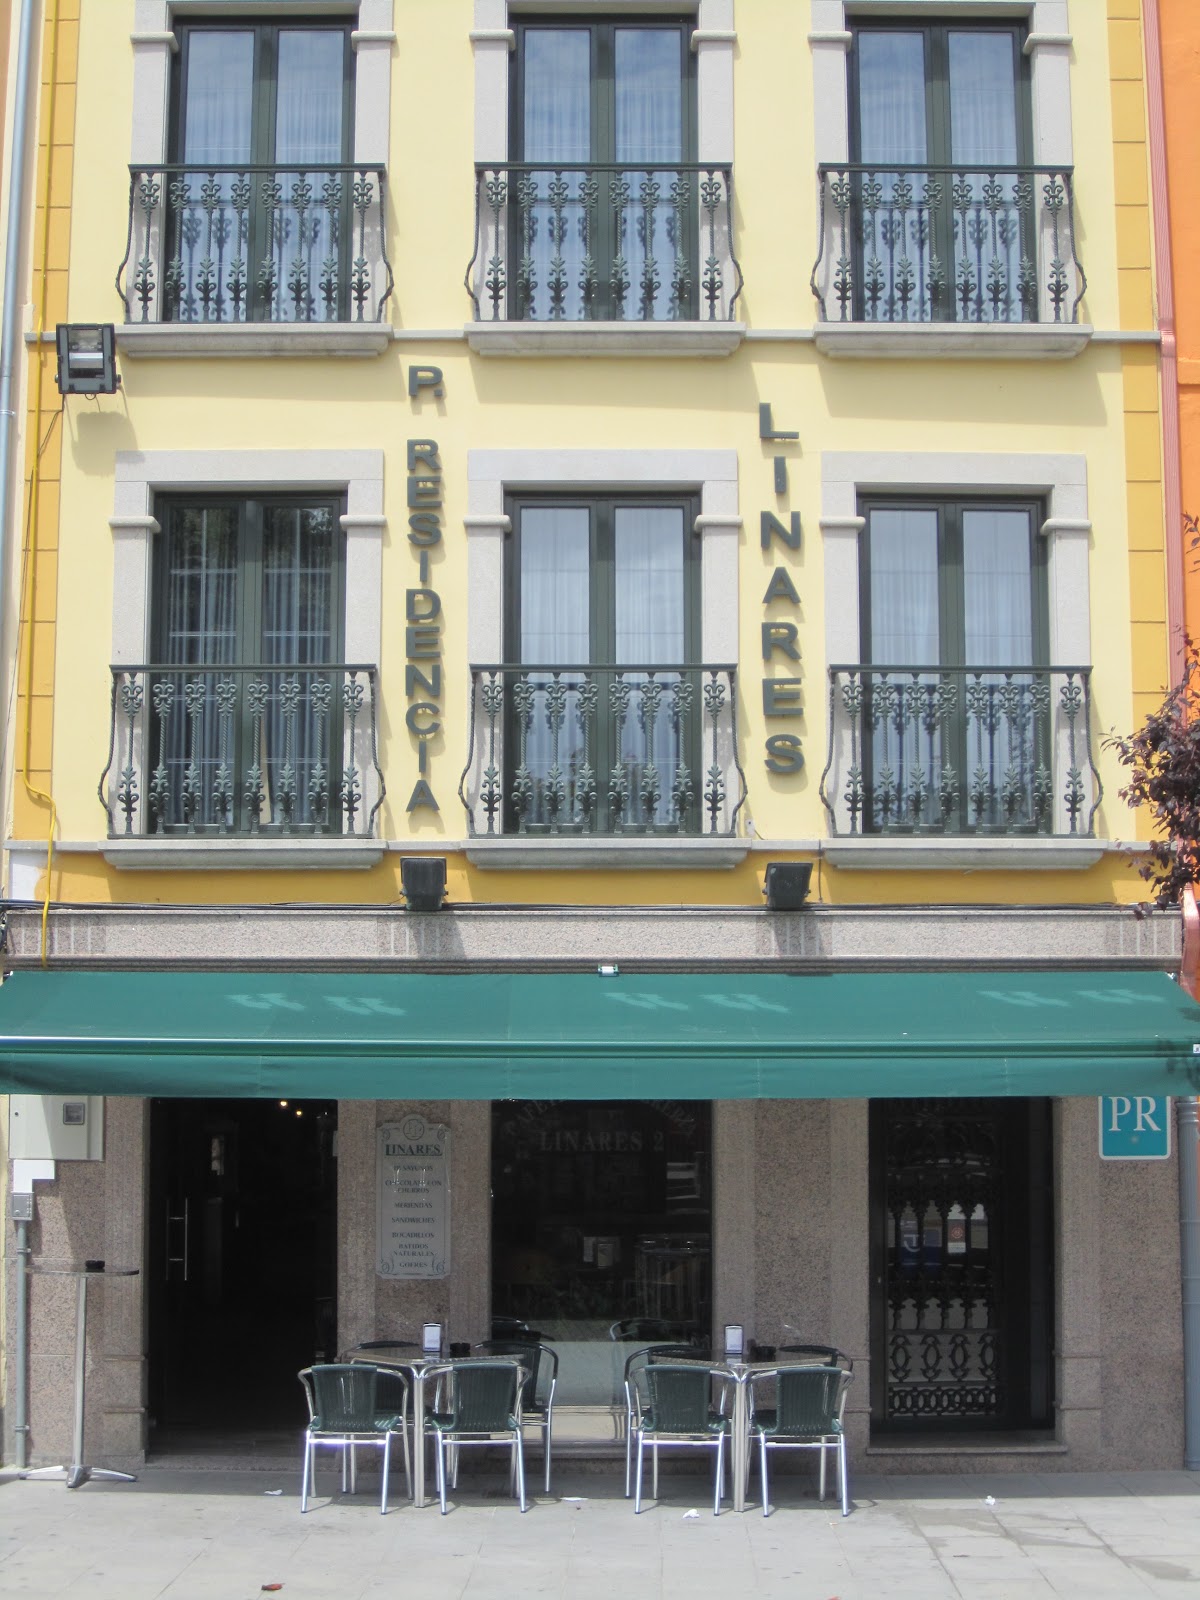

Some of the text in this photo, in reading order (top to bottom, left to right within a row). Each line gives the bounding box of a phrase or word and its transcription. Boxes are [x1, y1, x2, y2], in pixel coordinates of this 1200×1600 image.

[405, 365, 443, 813] P. RESIDENCIA
[759, 402, 805, 774] LINARES
[1108, 1096, 1161, 1131] PR
[385, 1144, 443, 1156] LINARES
[539, 1131, 664, 1151] LINARES 2
